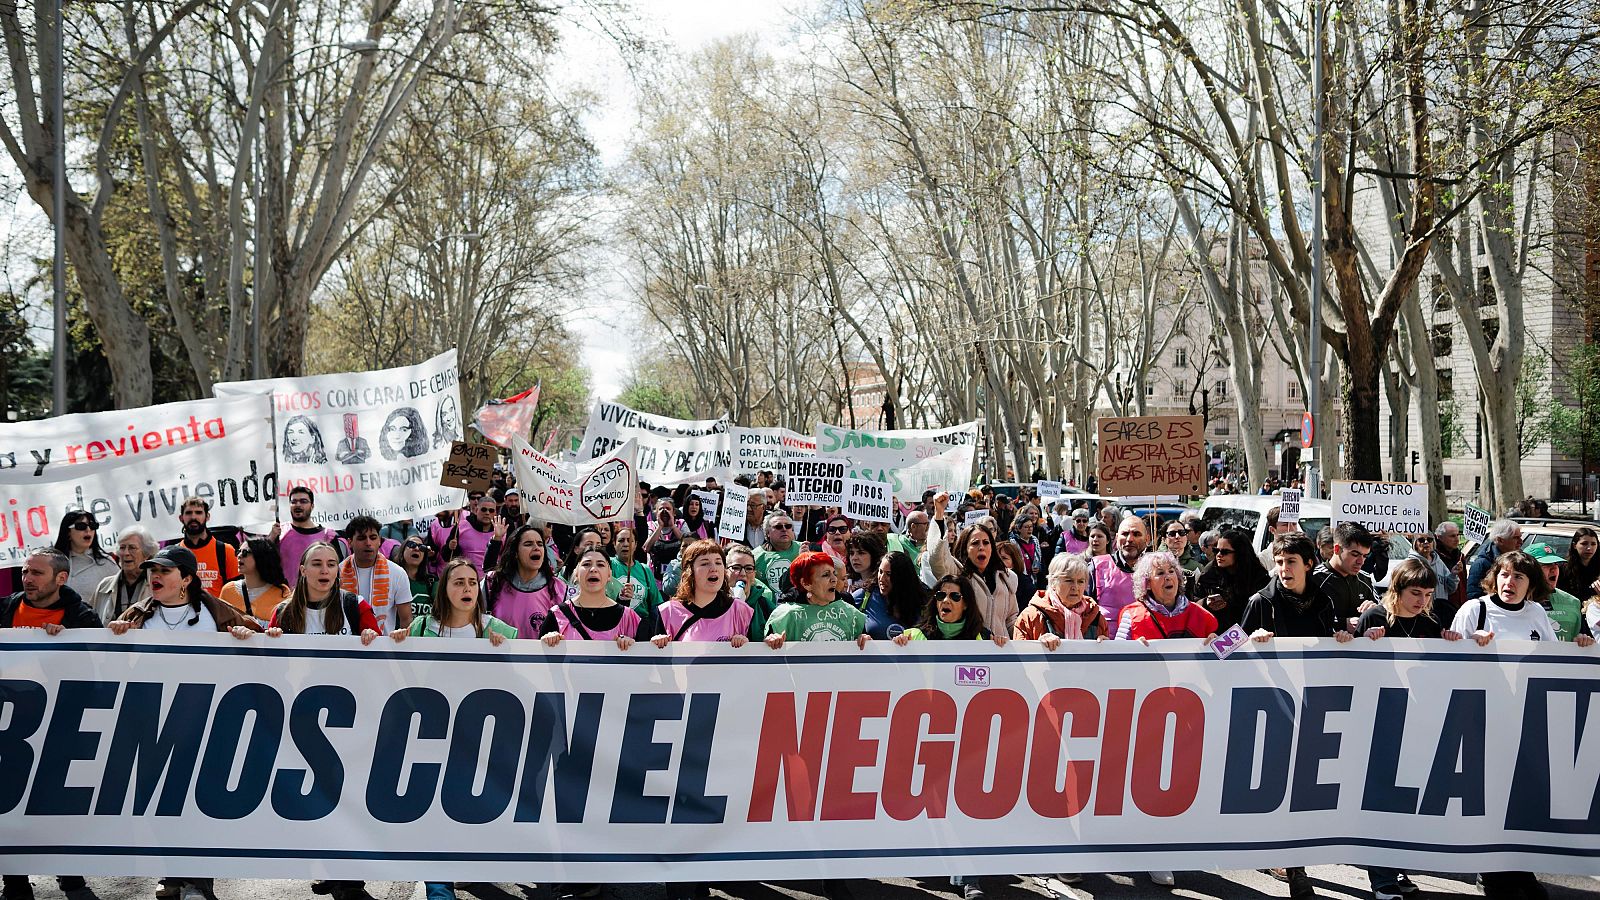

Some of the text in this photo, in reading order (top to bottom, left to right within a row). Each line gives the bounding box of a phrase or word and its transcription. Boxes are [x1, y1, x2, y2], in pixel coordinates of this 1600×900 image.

[327, 389, 359, 409] CON
[363, 386, 405, 407] CARA
[410, 379, 428, 400] DE
[740, 434, 761, 445] POR
[764, 435, 781, 446] UNA
[1103, 421, 1194, 442] SAREB ES
[30, 448, 51, 476] y
[66, 415, 226, 464] revienta
[1170, 441, 1201, 460] SUS
[661, 449, 677, 472] Y
[675, 450, 695, 472] DE
[739, 460, 746, 469] Y
[748, 460, 759, 469] DE
[360, 470, 382, 491] EN
[387, 461, 439, 488] MONTE
[591, 463, 625, 488] STOP
[788, 461, 845, 479] DERECHO
[1100, 464, 1145, 482] CASAS
[65, 485, 112, 526] de
[124, 459, 277, 522] vivienda
[788, 478, 844, 495] A TECHO
[1350, 482, 1413, 496] CATASTRO
[538, 491, 572, 511] CALLE
[788, 493, 842, 503] A JUSTO PRECIO!
[1282, 491, 1300, 502] DERECHO
[342, 508, 356, 520] de
[403, 503, 416, 513] de
[417, 493, 451, 512] Villalba
[848, 500, 889, 519] NO NICHOS!
[1285, 503, 1300, 513] TECHO
[1342, 503, 1421, 516] COMPLICE de la
[1337, 519, 1425, 534] ECULACION
[770, 566, 788, 578] STO
[411, 602, 433, 614] STO
[816, 607, 848, 621] CASA
[0, 679, 358, 821] BEMOS
[365, 686, 606, 825] CON
[608, 692, 729, 825] EL
[746, 686, 1206, 823] NEGOCIO
[1219, 685, 1354, 815] DE
[1361, 687, 1487, 817] LA
